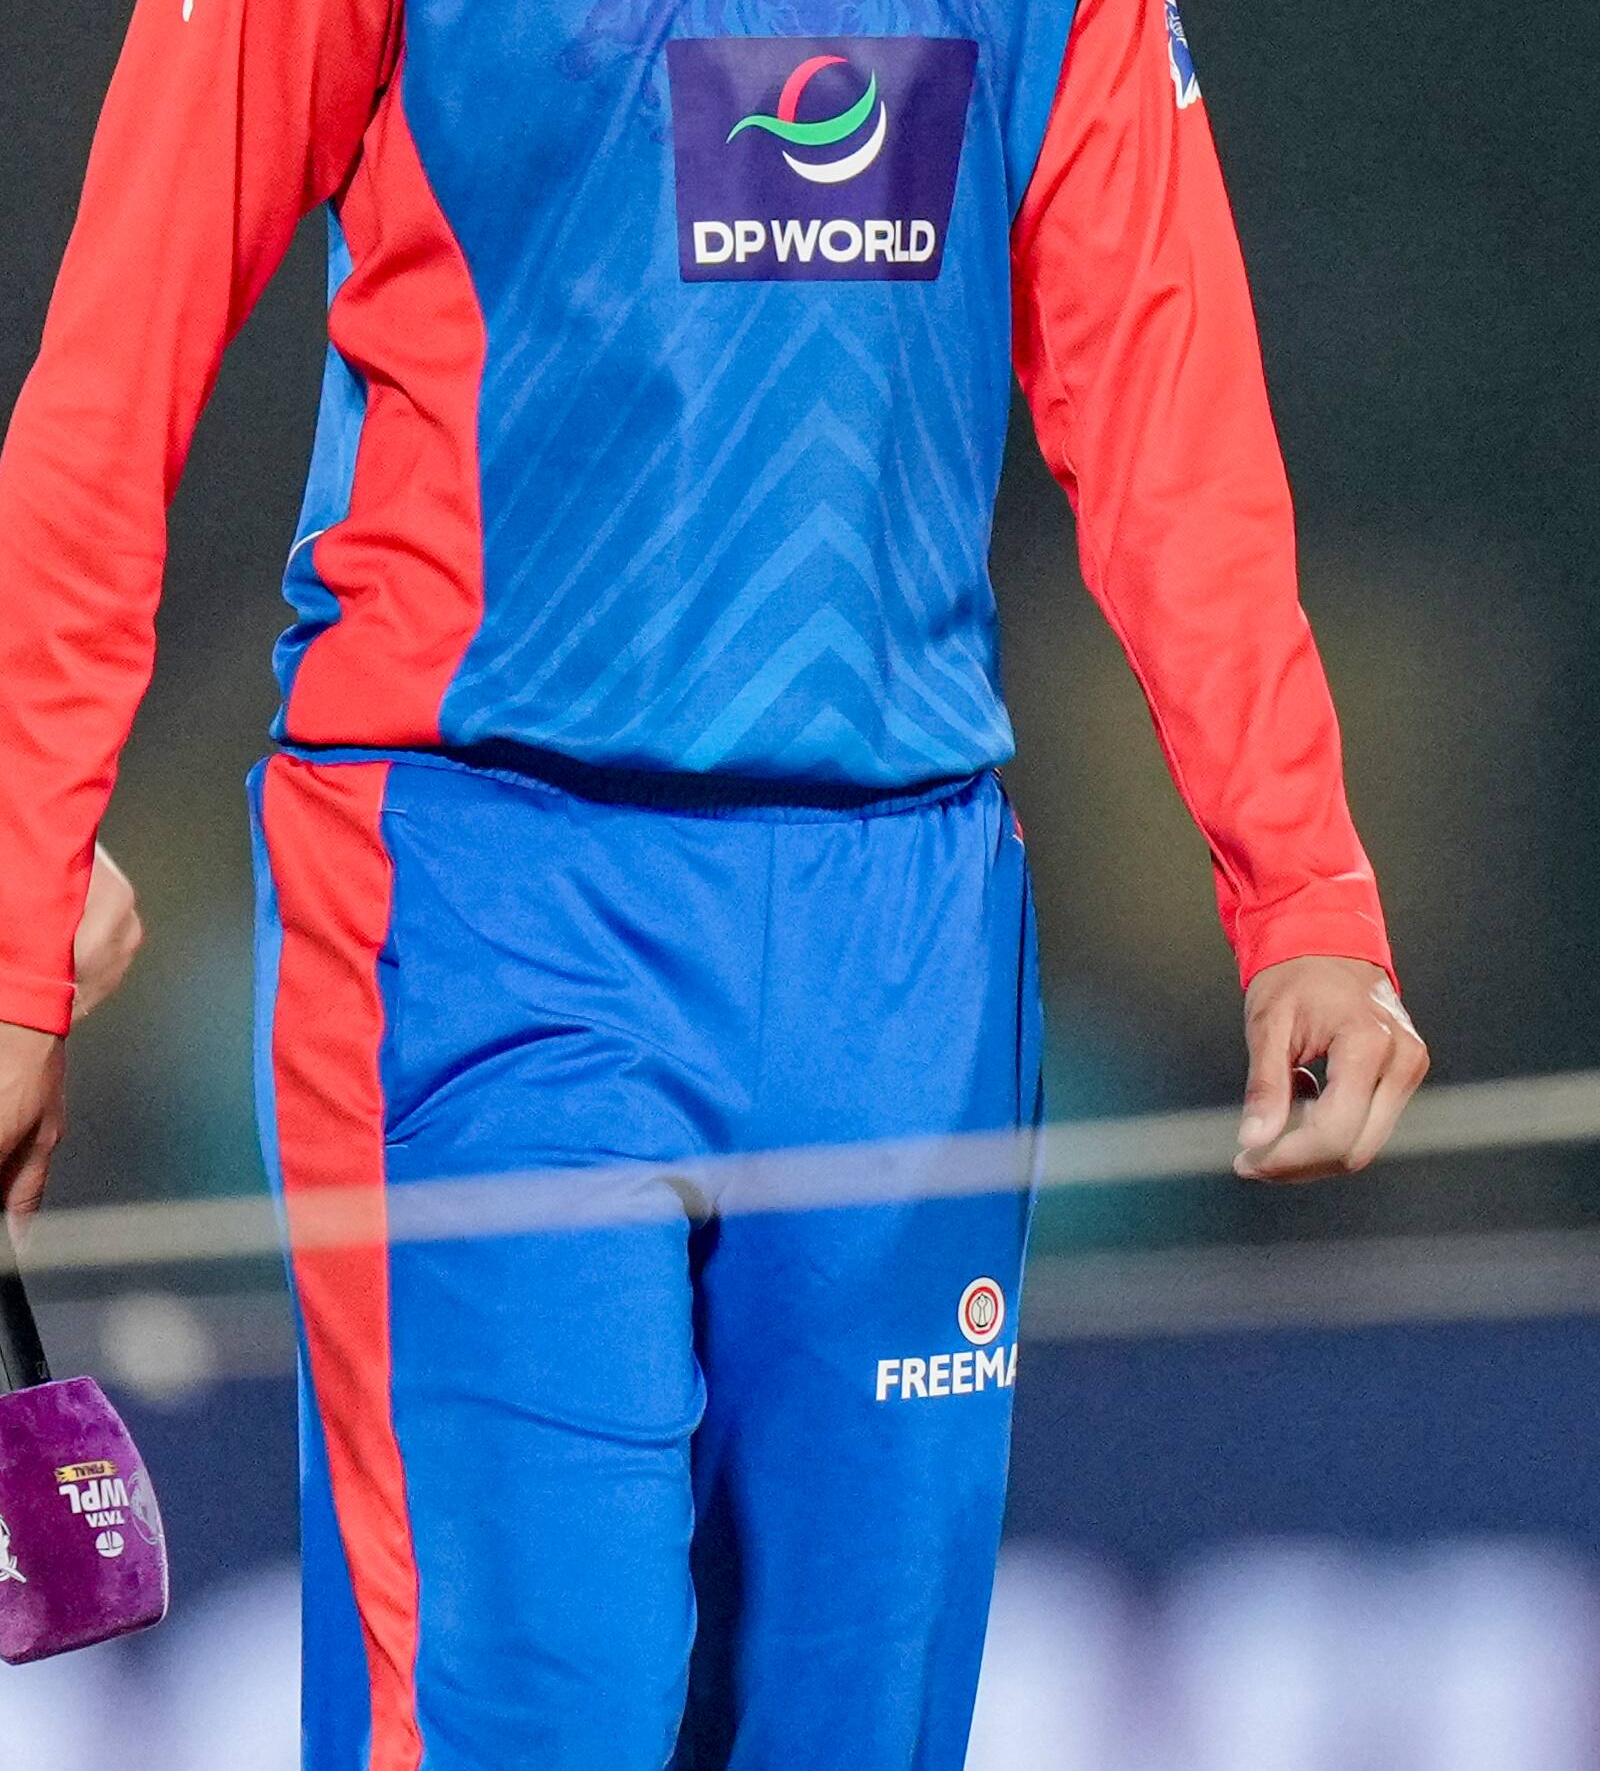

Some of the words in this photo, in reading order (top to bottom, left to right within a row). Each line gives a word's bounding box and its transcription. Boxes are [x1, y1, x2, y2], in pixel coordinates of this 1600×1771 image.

[693, 220, 766, 263] DP
[770, 219, 936, 263] WORLD
[59, 1478, 130, 1514] WPL
[85, 1510, 125, 1528] TATA
